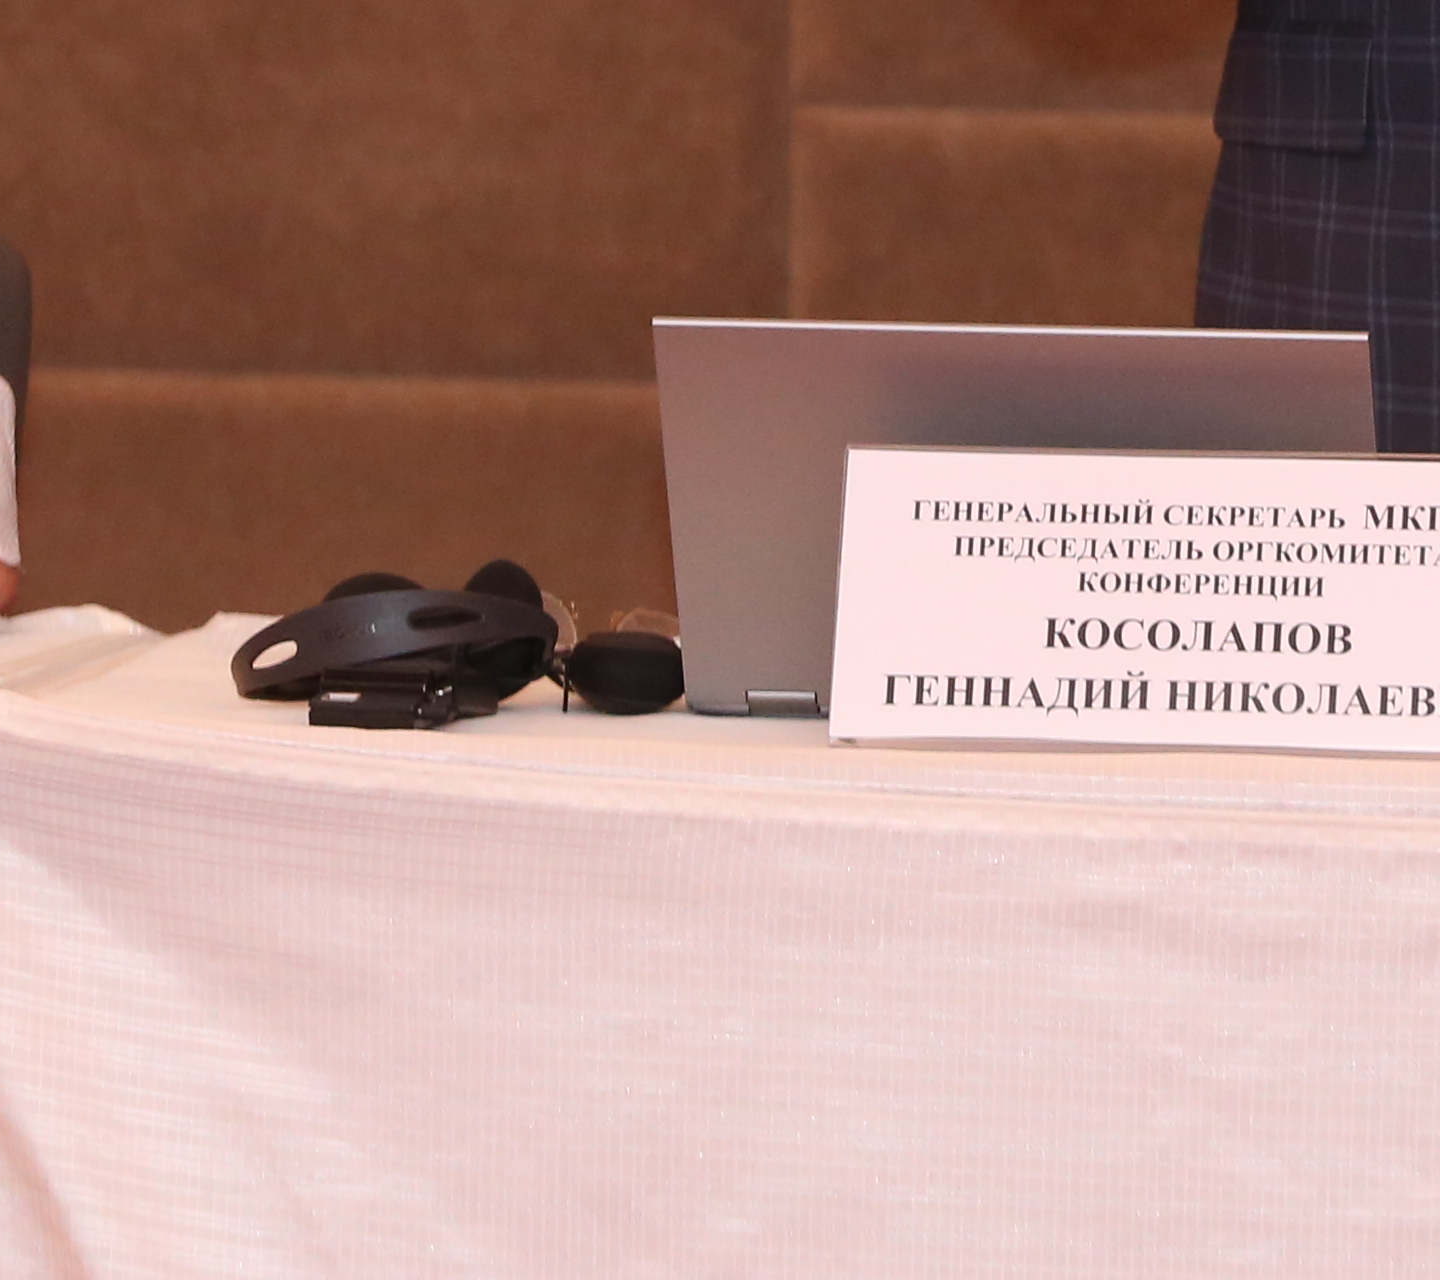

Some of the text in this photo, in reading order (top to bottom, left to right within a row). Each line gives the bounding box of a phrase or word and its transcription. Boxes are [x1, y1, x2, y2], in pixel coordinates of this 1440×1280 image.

[913, 499, 1153, 524] ГЕНЕРАЛЬНЫЙ
[1164, 505, 1346, 528] СЕКРЕТАРЬ
[955, 537, 1203, 562] ПРЕДСЕДАТЕЛЬ
[1079, 572, 1324, 599] КОНФЕРЕНЦИИ
[1046, 617, 1352, 654] КОСОЛАПОВ
[885, 670, 1149, 716] ГЕННАДИЙ
